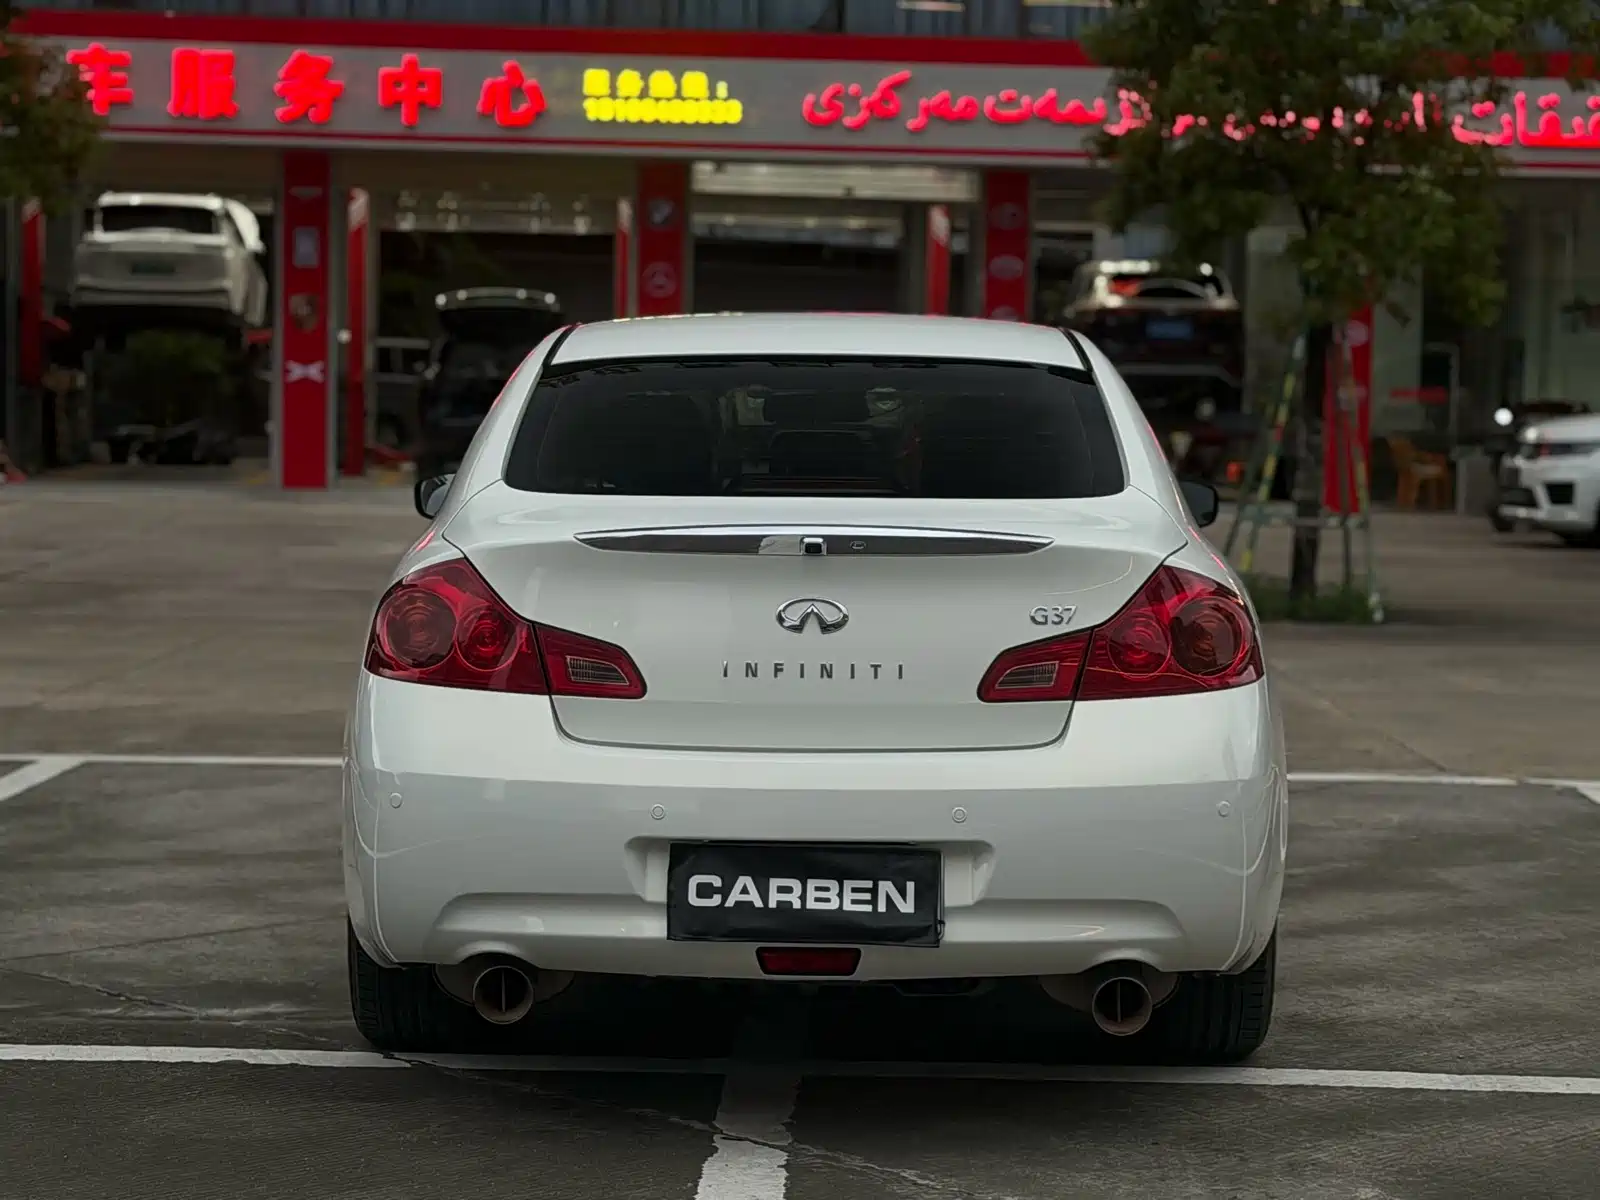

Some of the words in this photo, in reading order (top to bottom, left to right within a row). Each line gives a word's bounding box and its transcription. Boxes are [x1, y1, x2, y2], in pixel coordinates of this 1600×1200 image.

[1029, 605, 1077, 625] G37
[722, 661, 904, 680] INFINITI
[687, 874, 915, 914] CARBEN
